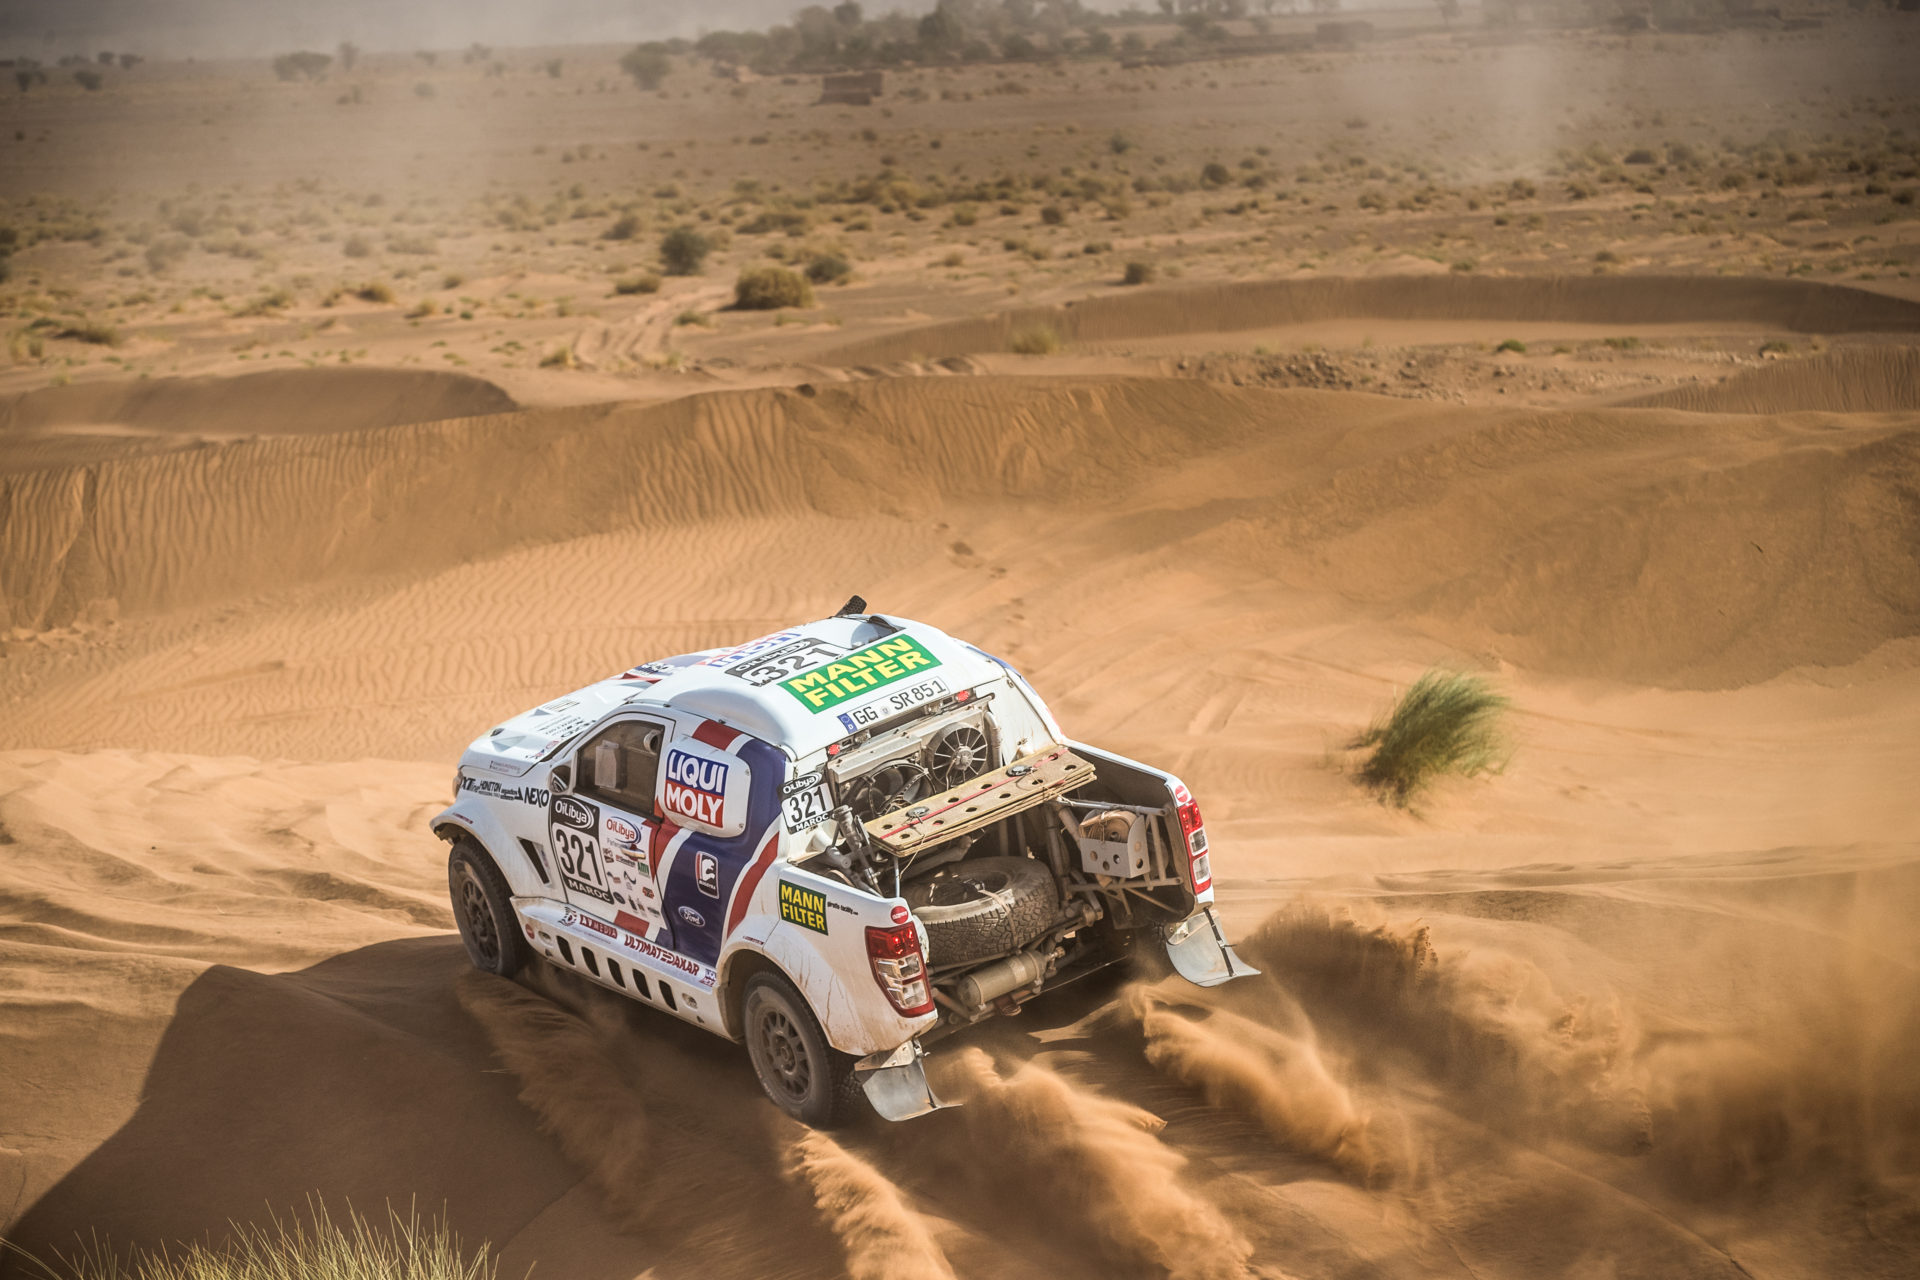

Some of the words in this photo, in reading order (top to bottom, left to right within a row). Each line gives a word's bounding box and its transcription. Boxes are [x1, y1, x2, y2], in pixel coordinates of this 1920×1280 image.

[750, 648, 840, 682] 321
[788, 638, 913, 692] MANN
[804, 651, 931, 707] FILTER
[853, 706, 878, 725] GG
[890, 692, 914, 710] SR
[912, 680, 946, 701] 851
[668, 751, 725, 793] LIQUI
[524, 787, 549, 808] NEXO
[555, 801, 587, 823] OiLibya
[666, 783, 723, 824] MOLY
[790, 786, 826, 822] 321
[606, 819, 635, 839] OiLibya
[796, 813, 828, 831] MAROC
[556, 829, 602, 886] 321
[568, 880, 610, 901] MAROC
[781, 884, 823, 913] MANN
[684, 908, 701, 925] Ford
[782, 902, 825, 931] FILTER
